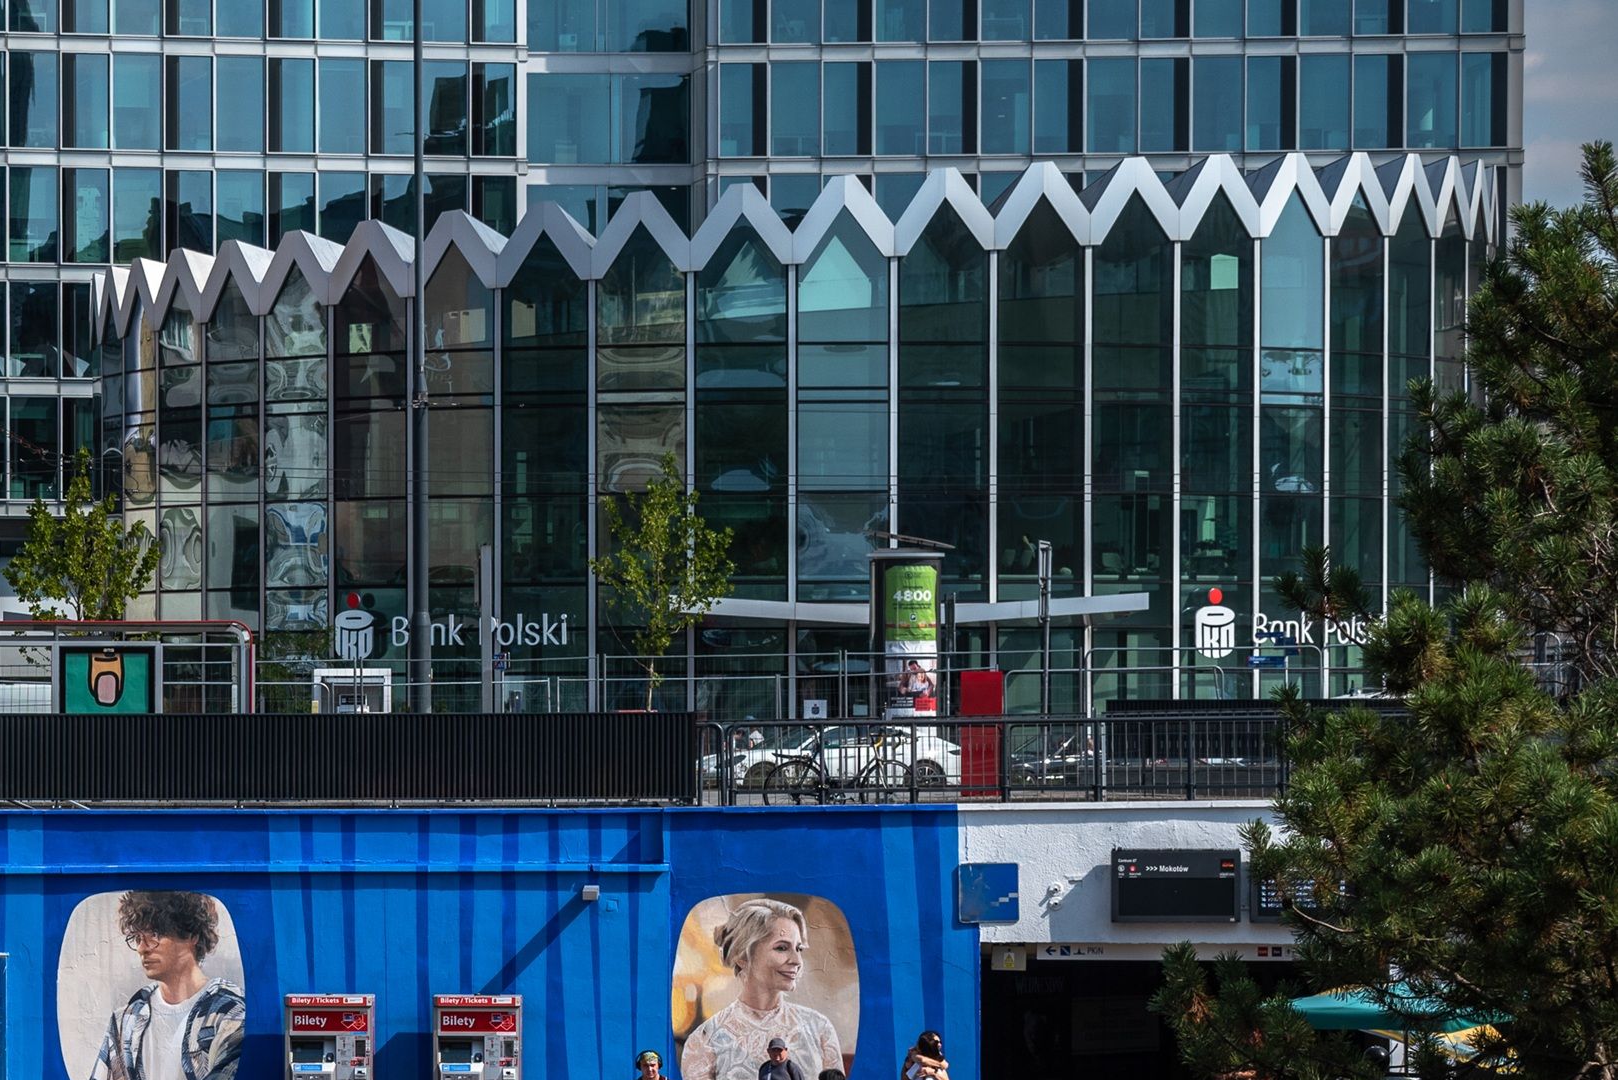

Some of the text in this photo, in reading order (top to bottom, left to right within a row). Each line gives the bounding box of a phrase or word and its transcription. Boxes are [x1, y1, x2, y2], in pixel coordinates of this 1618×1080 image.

[893, 590, 932, 601] 4800
[392, 613, 465, 646] Bnk
[1159, 864, 1189, 873] Mokotów
[440, 997, 459, 1005] Bilety
[294, 1015, 327, 1028] Bilety
[442, 1015, 475, 1028] Bilety
